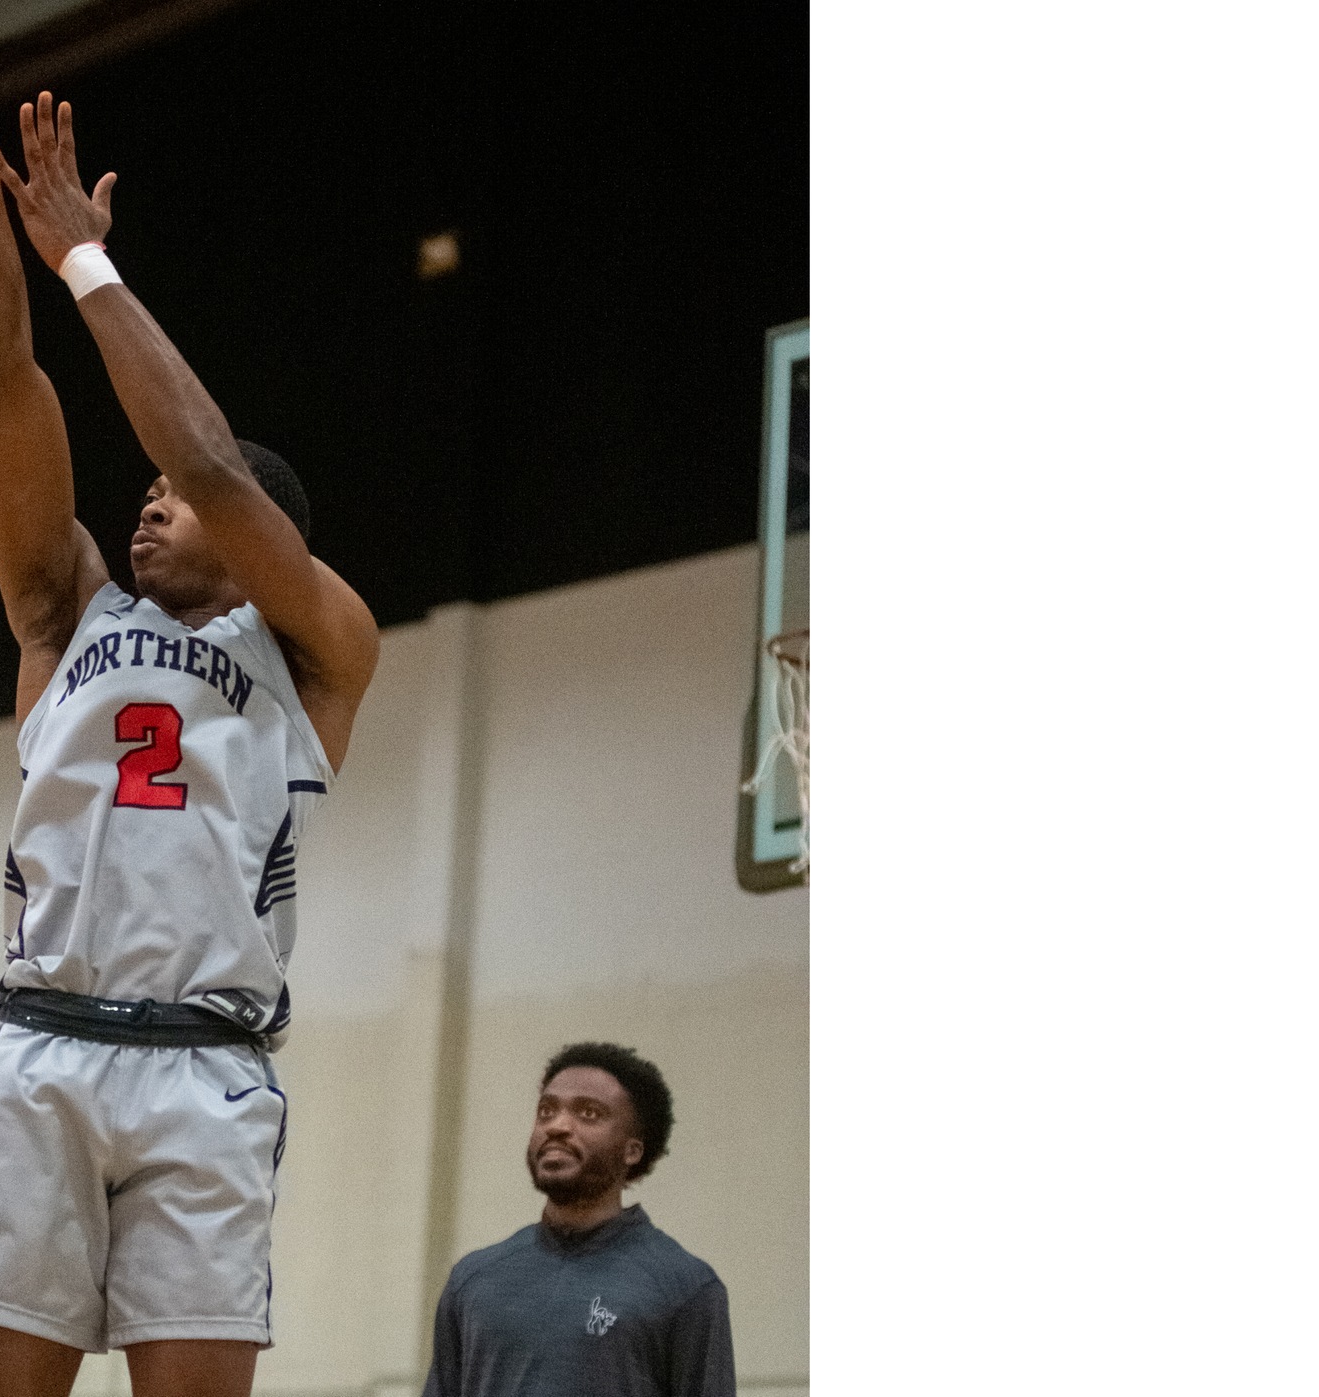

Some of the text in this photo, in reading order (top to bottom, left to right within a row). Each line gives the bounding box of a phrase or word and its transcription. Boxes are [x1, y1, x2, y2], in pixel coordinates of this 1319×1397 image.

[56, 628, 254, 716] NORTHERN
[114, 702, 188, 810] 2
[242, 1007, 257, 1022] M
